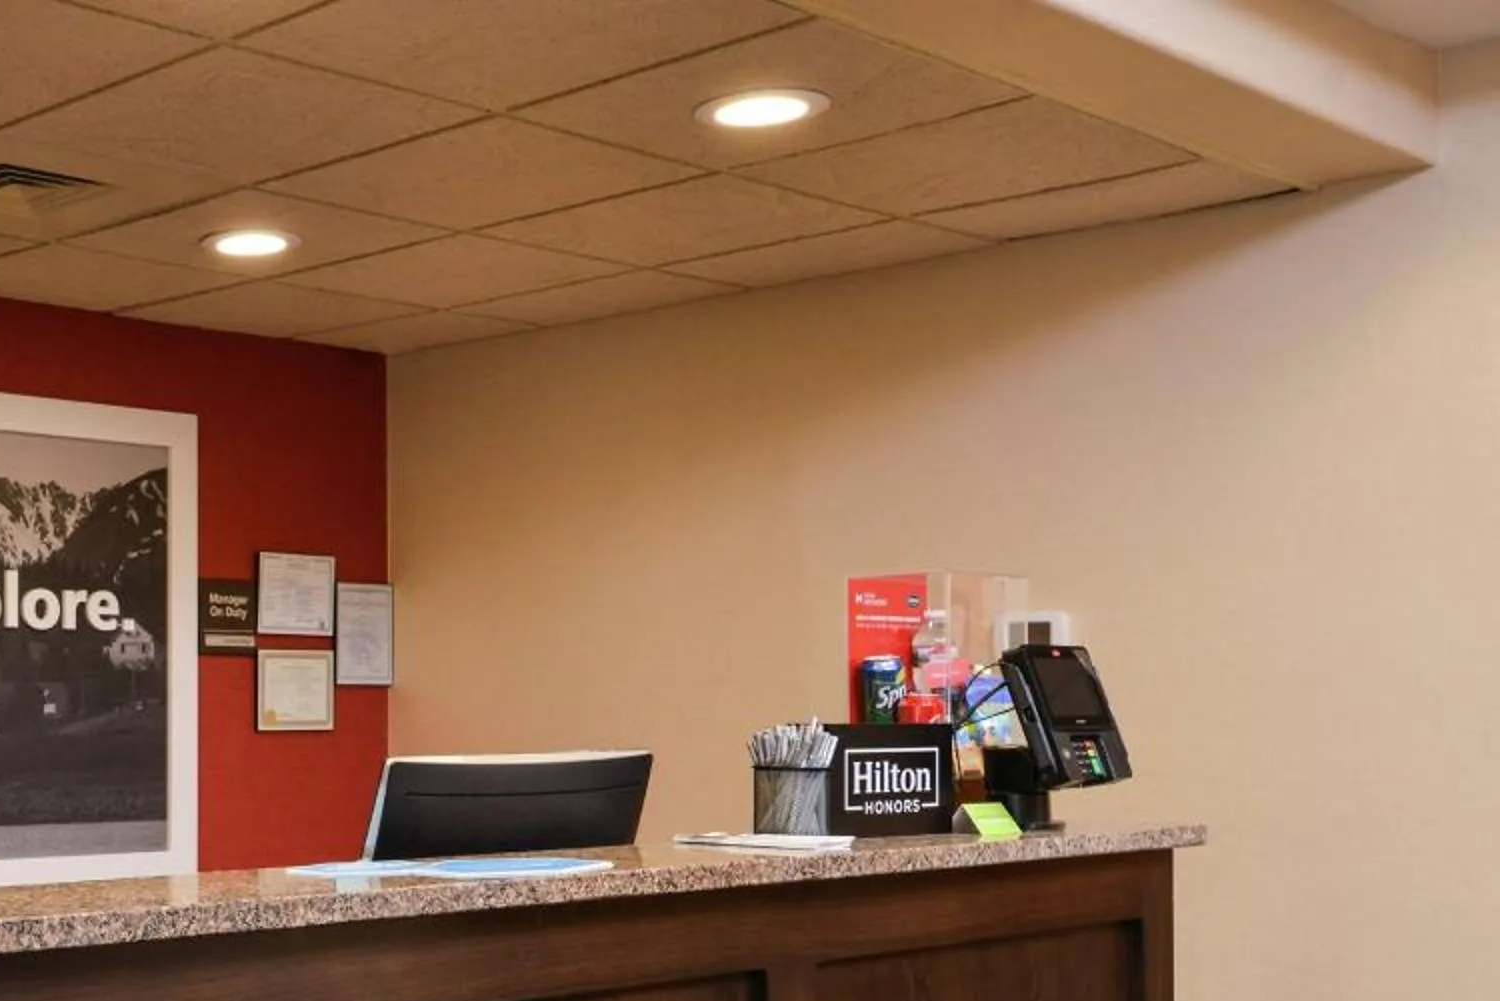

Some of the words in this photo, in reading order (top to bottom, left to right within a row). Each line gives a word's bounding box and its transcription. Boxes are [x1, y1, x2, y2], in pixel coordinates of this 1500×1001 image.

[209, 592, 249, 607] Manager
[209, 605, 224, 617] On
[225, 605, 248, 621] Duty
[852, 761, 932, 795] Hilton
[864, 799, 921, 816] HONORS
